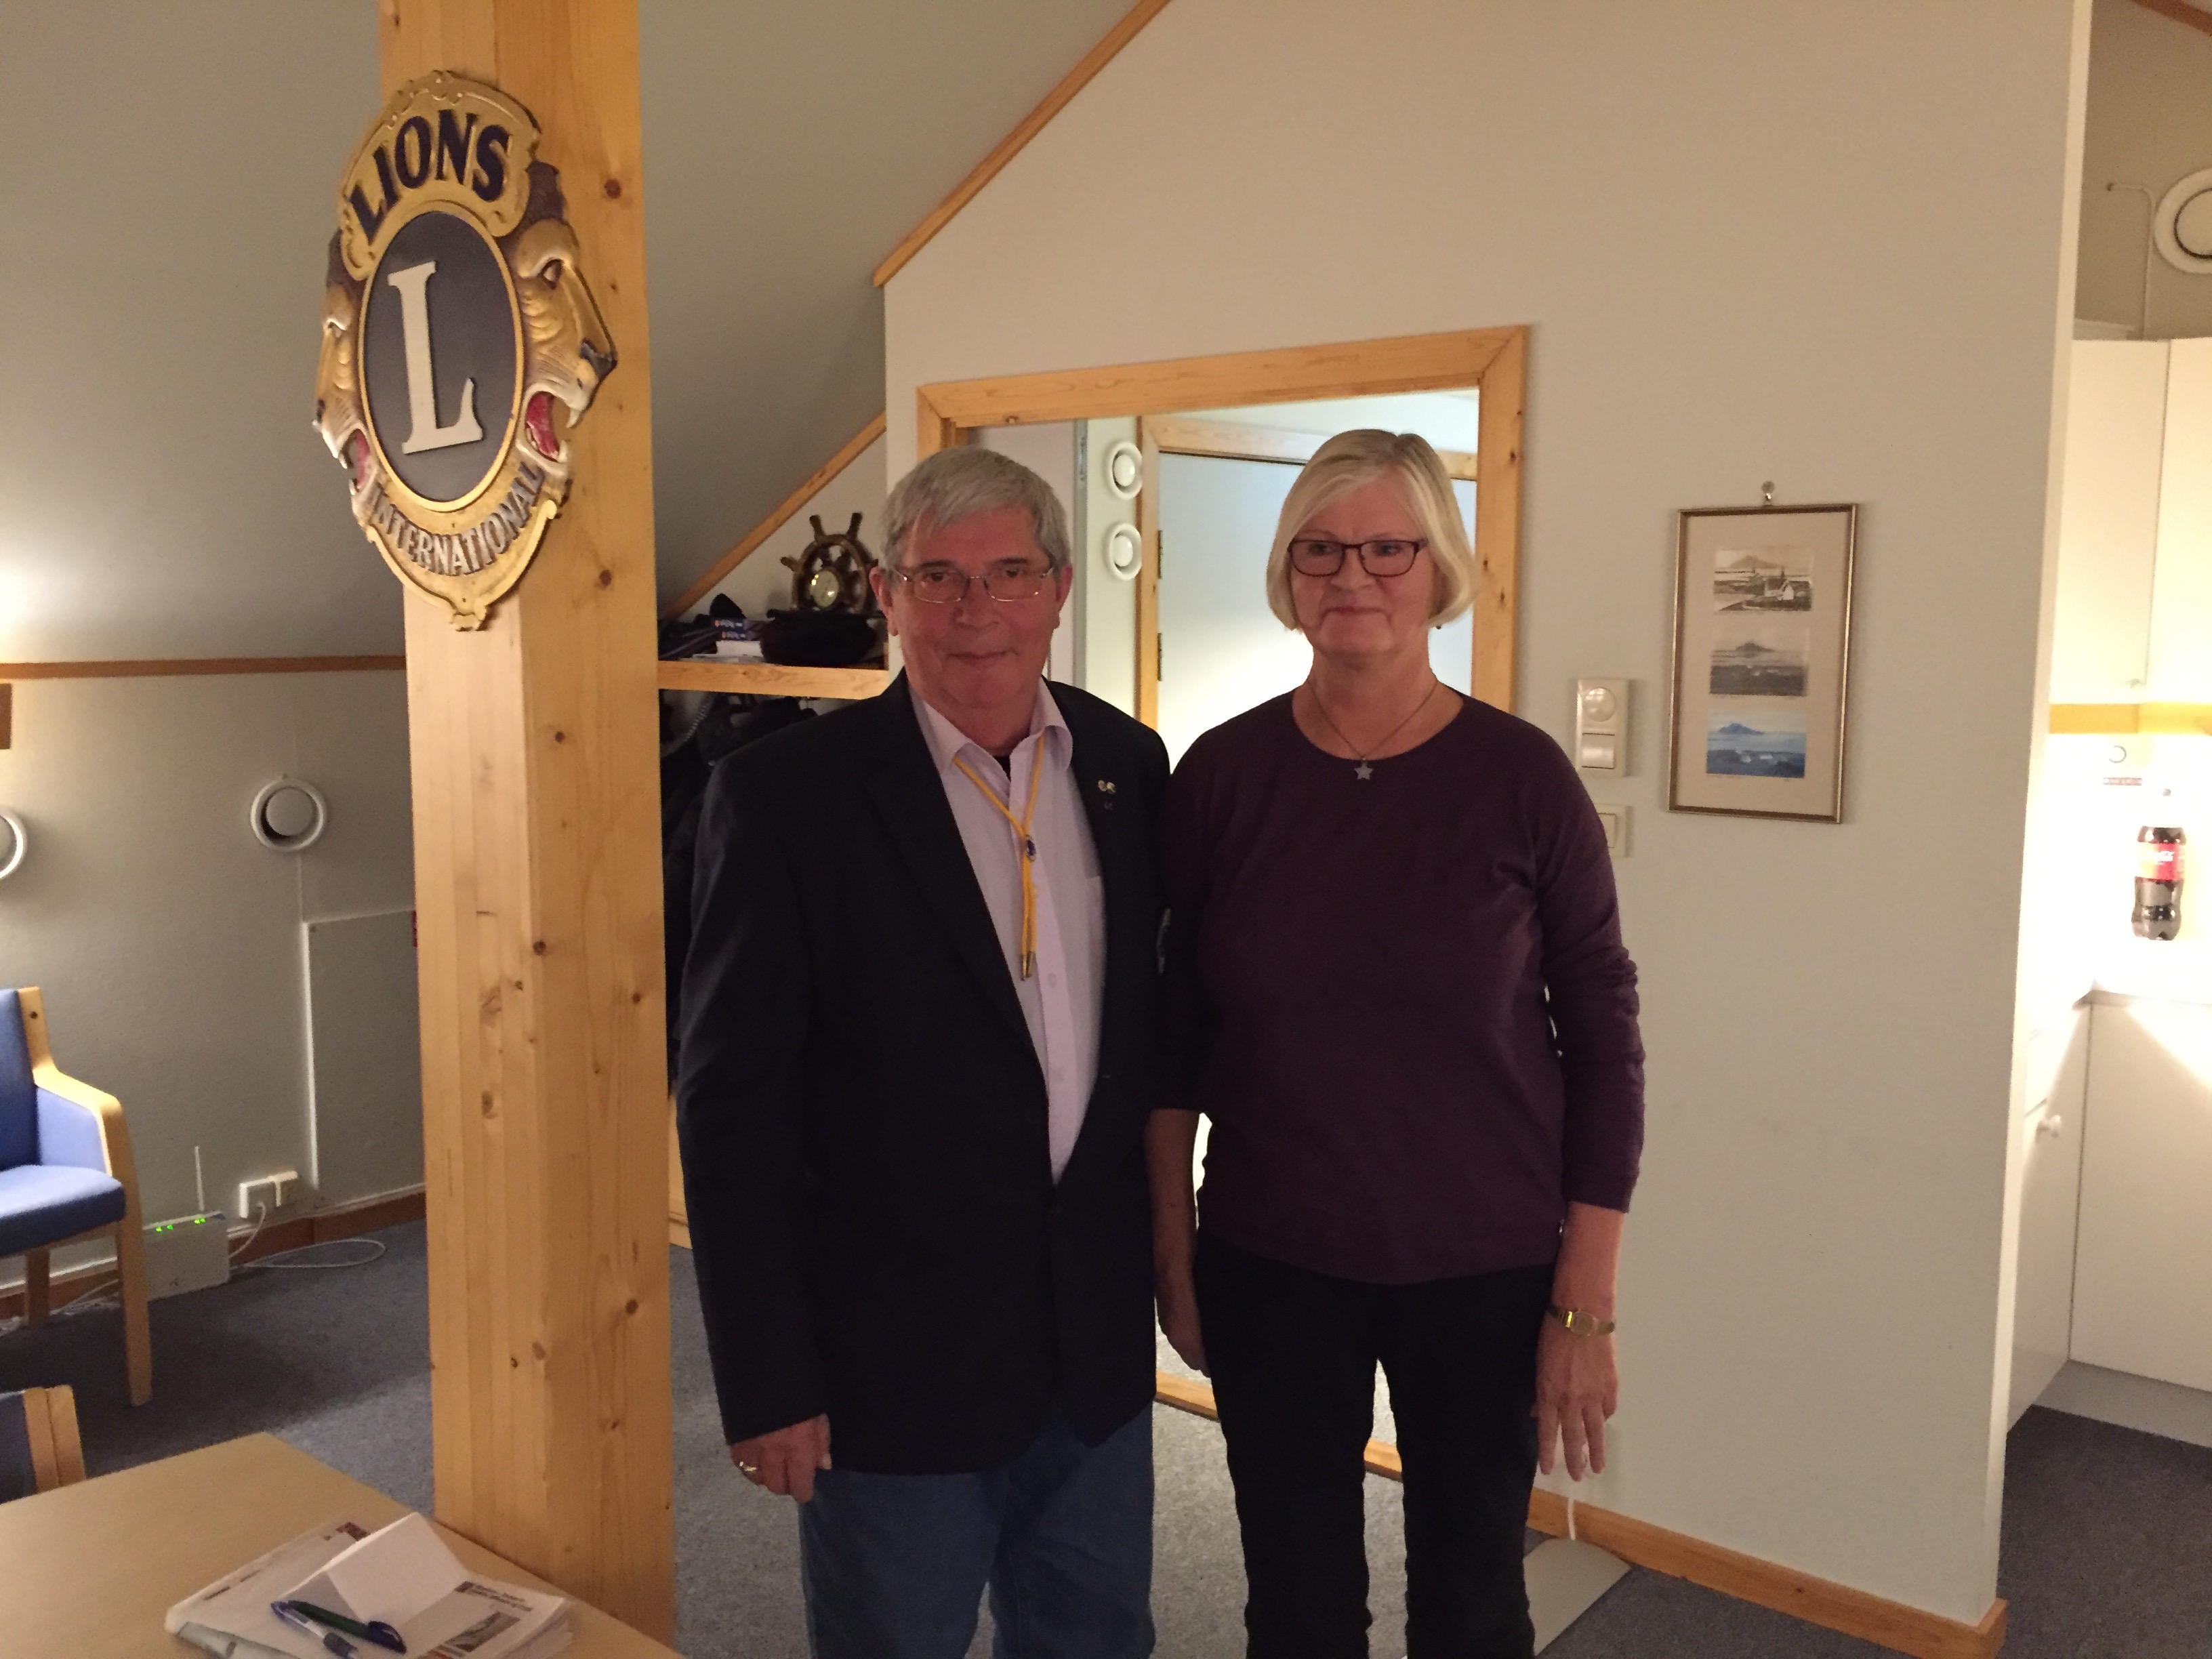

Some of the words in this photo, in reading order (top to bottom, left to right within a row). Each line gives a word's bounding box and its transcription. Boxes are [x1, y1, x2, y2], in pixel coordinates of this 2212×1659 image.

[348, 108, 510, 242] LIONS
[387, 261, 484, 455] L
[369, 462, 544, 577] INTERNATIONAL
